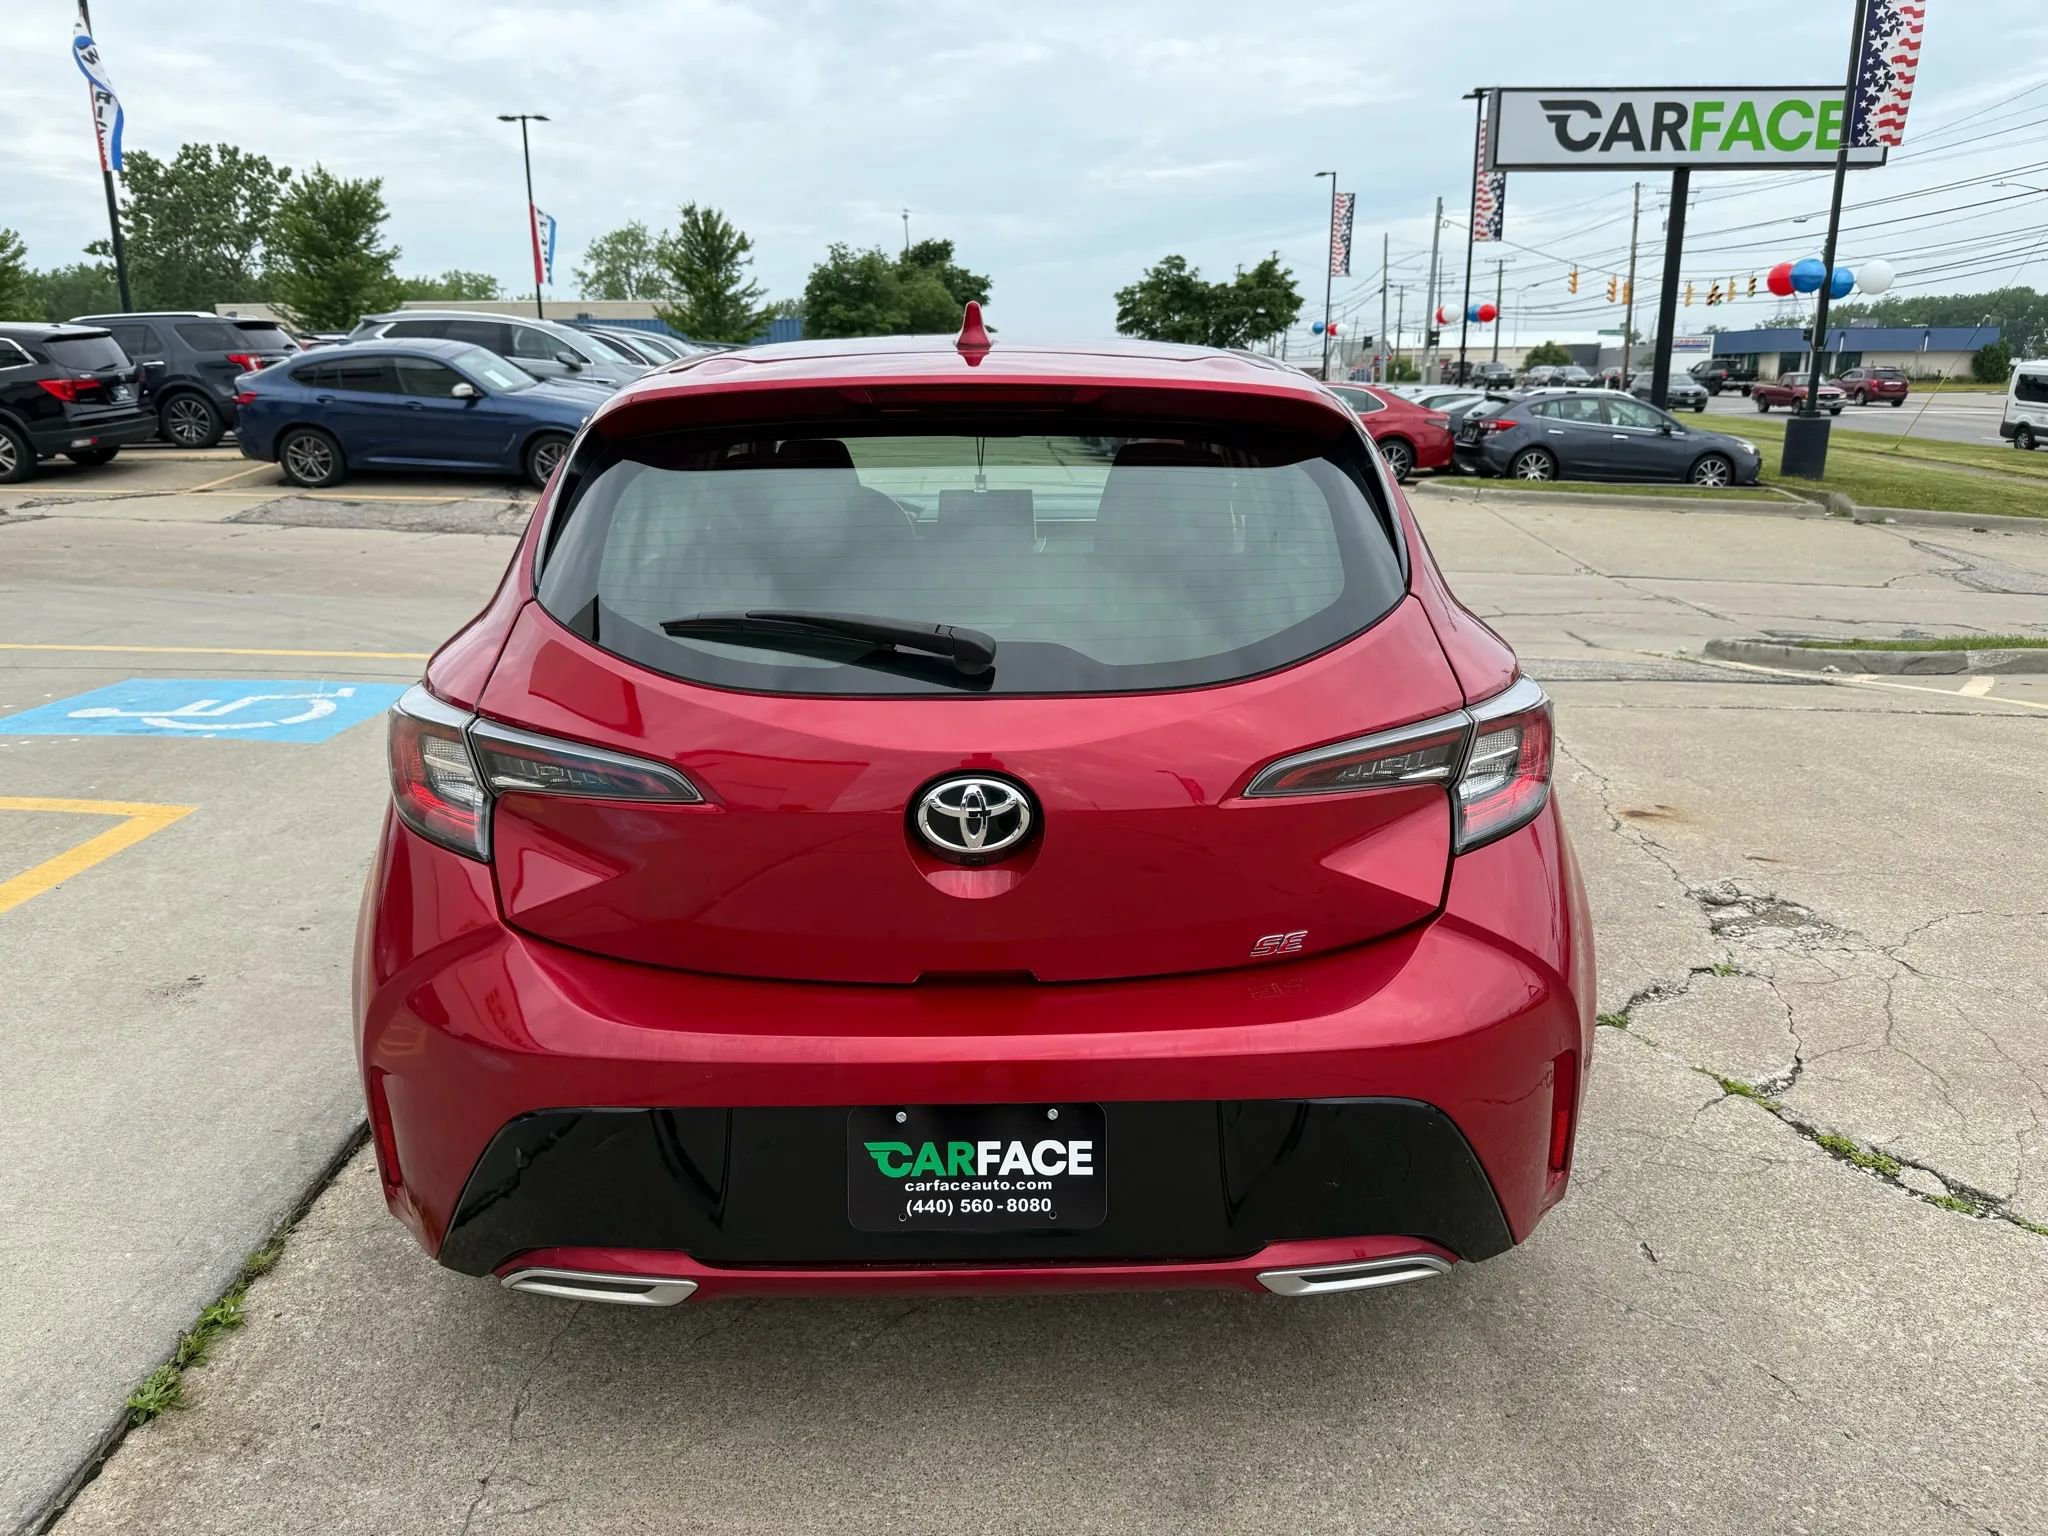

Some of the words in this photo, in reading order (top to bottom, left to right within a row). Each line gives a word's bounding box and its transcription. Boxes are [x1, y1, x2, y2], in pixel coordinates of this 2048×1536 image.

[1538, 99, 1845, 153] CARFACE
[1249, 930, 1308, 957] SE
[863, 1139, 1094, 1178] CARFACE
[904, 1179, 1053, 1192] carfaceauto.com
[906, 1199, 954, 1216] (440)
